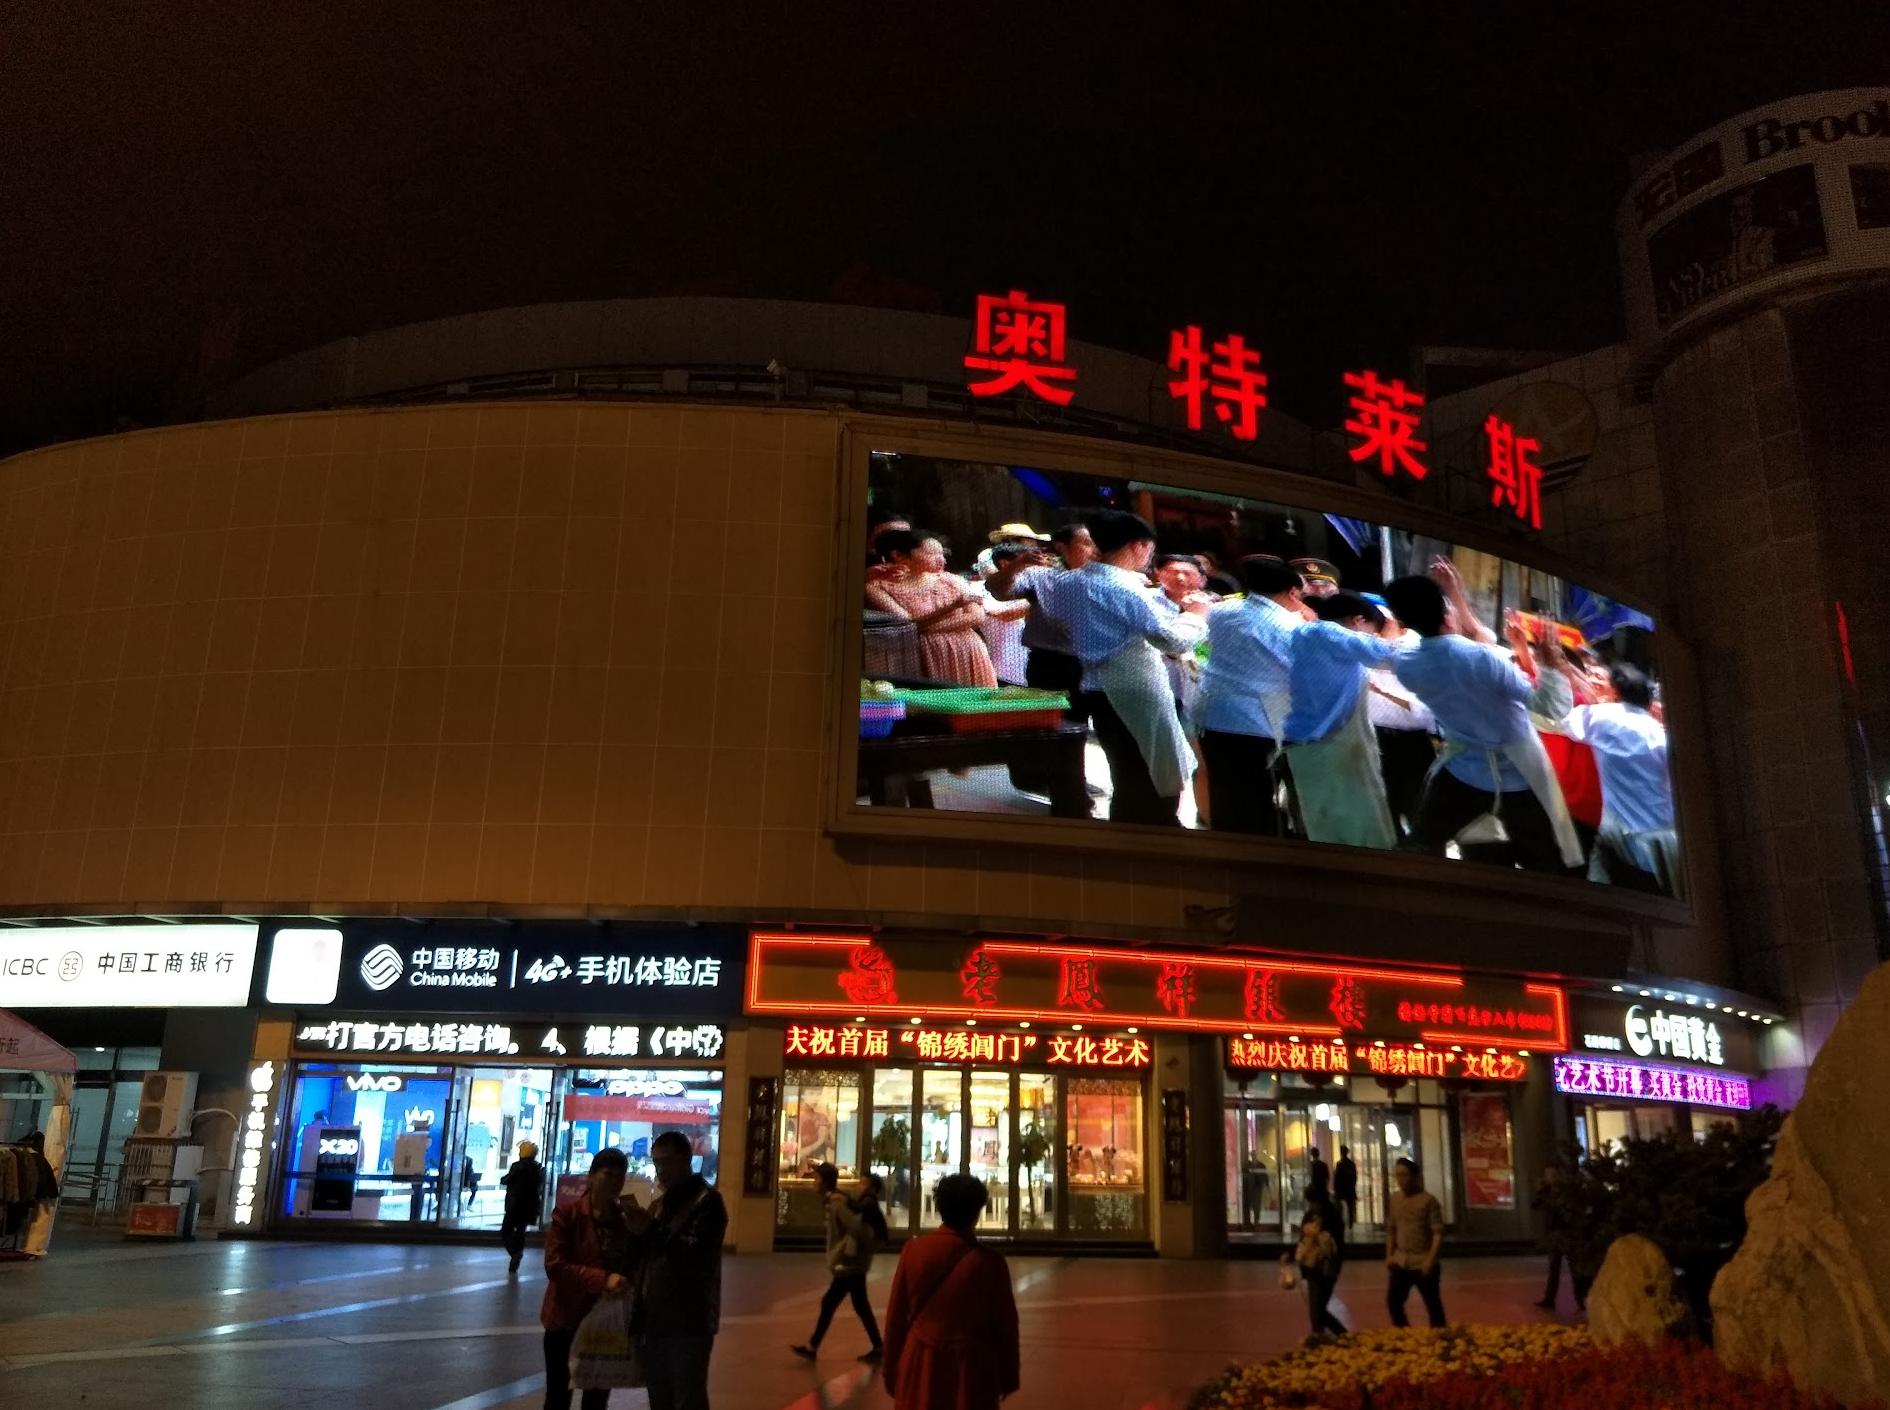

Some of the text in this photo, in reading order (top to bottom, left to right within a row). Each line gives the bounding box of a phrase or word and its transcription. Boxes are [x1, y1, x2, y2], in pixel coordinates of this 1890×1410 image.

[964, 290, 1543, 530] 奥特莱斯
[2, 957, 50, 977] ICBC
[97, 951, 236, 975] 中国工商银行
[411, 946, 499, 972] 中国移动
[409, 970, 498, 988] China Mobile
[576, 955, 723, 988] 手机体验店
[319, 1138, 359, 1155] X20
